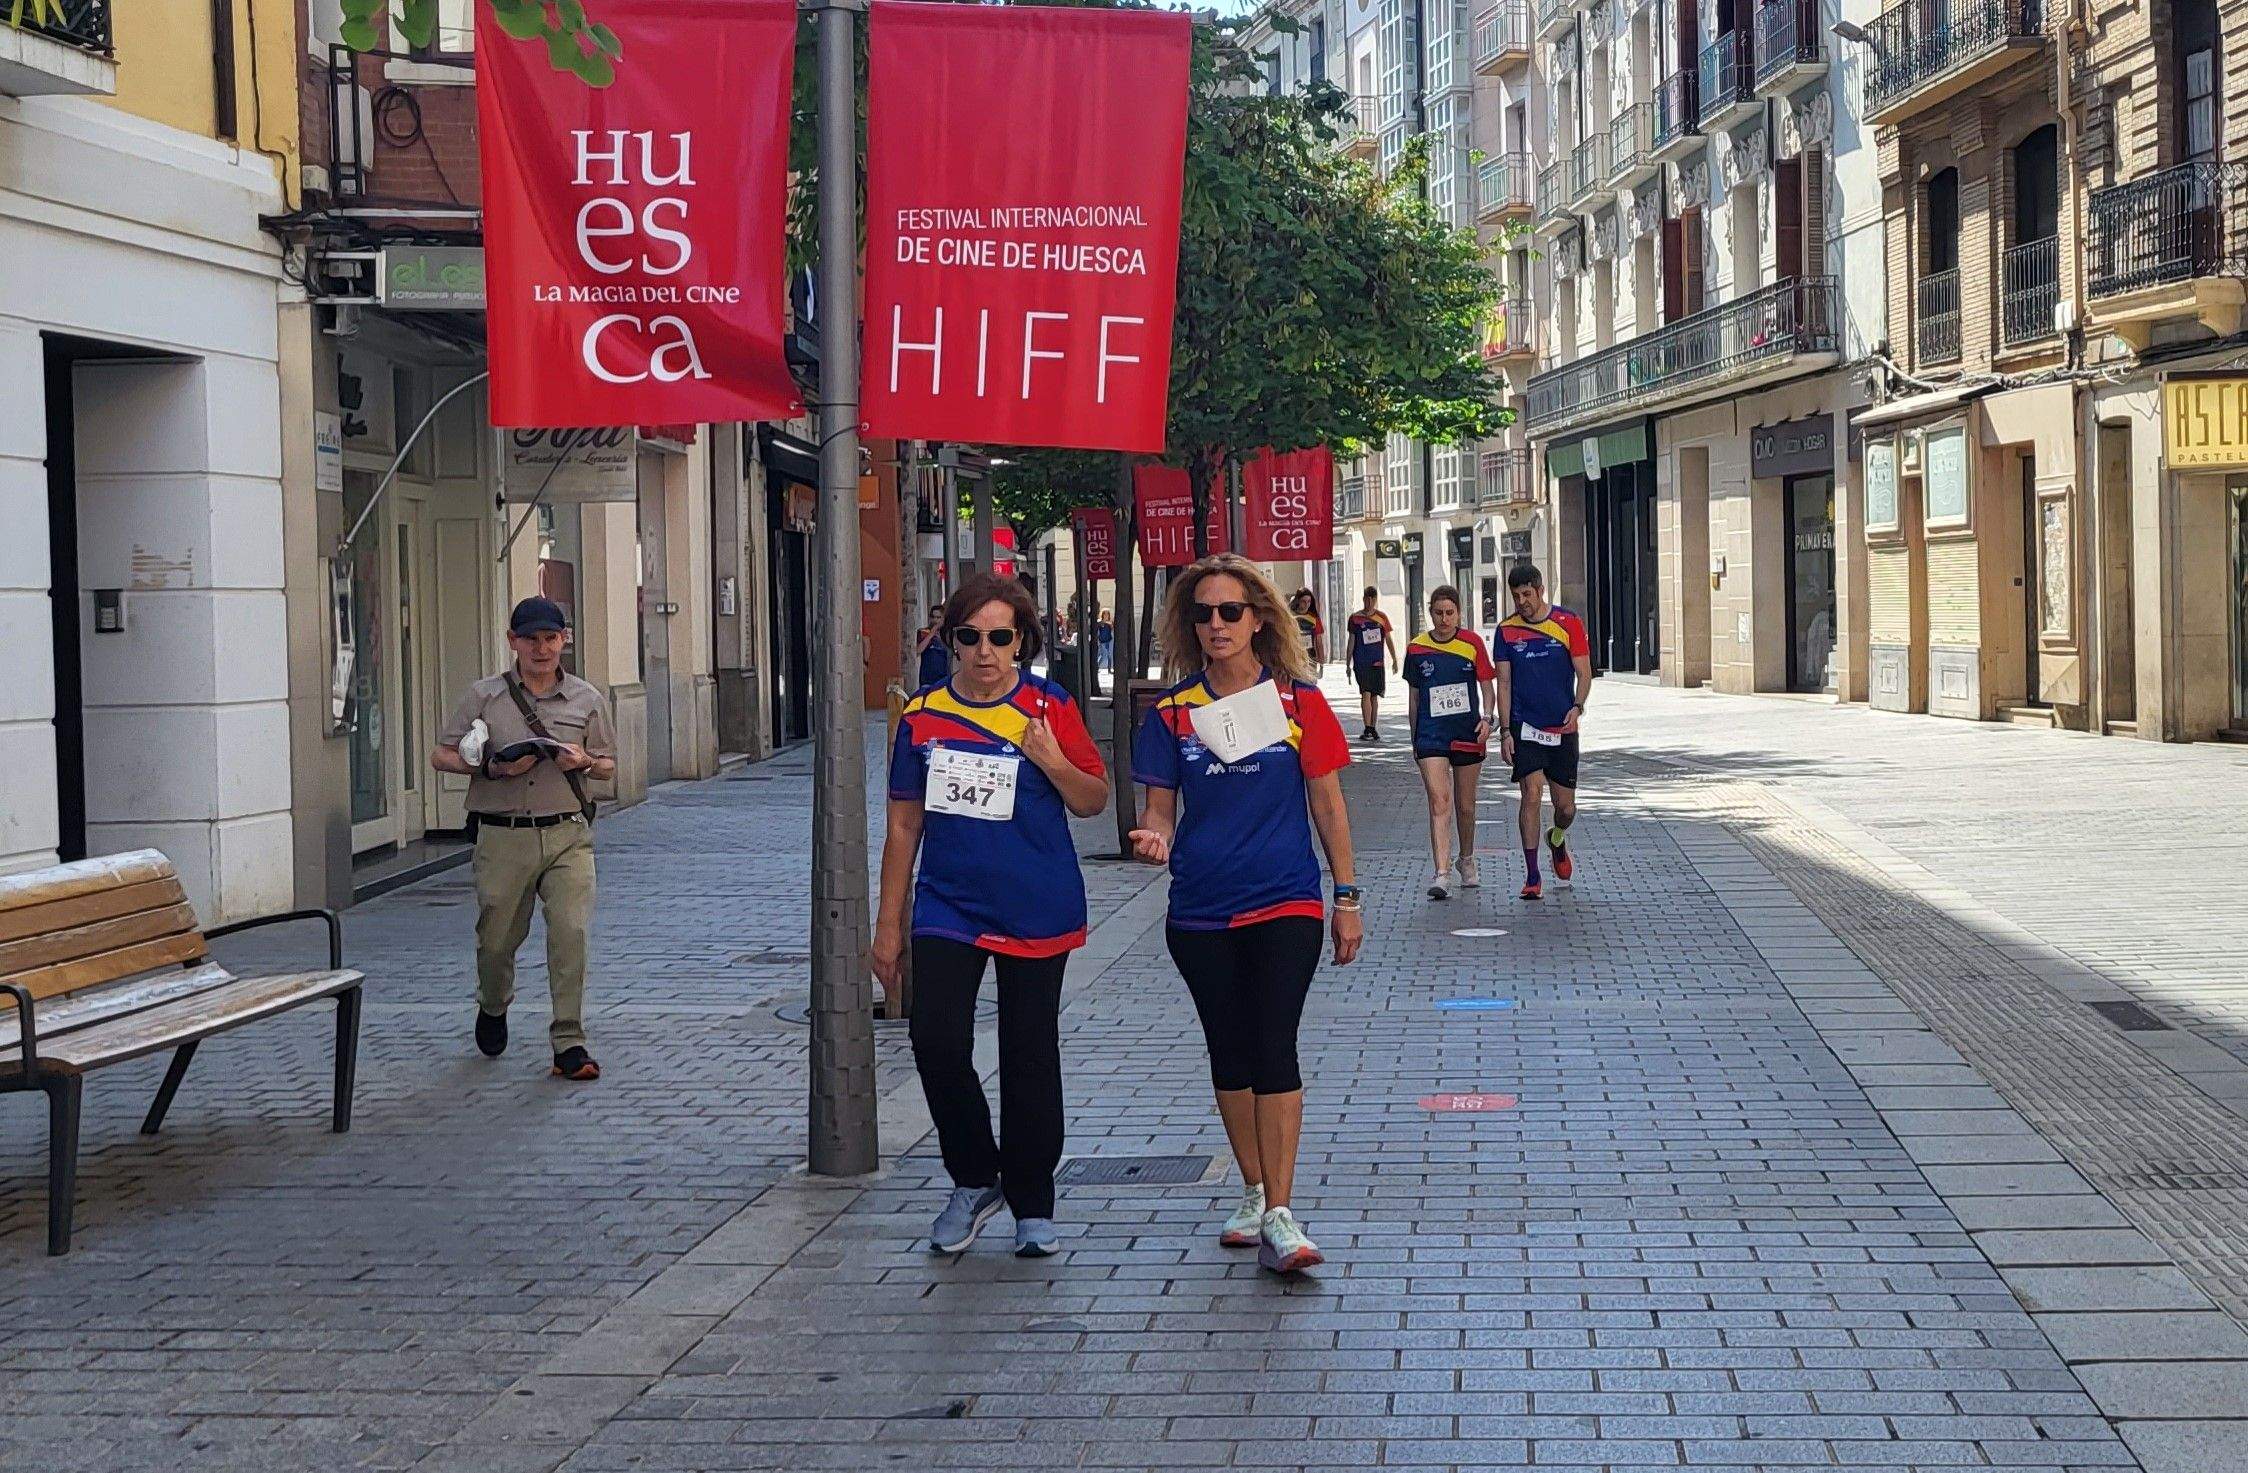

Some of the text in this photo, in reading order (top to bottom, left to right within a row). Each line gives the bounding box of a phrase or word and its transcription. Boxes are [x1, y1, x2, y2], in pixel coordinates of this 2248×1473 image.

[897, 206, 1148, 230] FESTIVAL INTERNACIONAL
[576, 197, 692, 275] es
[897, 236, 1147, 275] DE CINE DE HUESCA
[890, 304, 1145, 404] HIFF
[1271, 495, 1307, 518] es
[1228, 762, 1260, 775] mupol
[946, 782, 996, 808] 347
